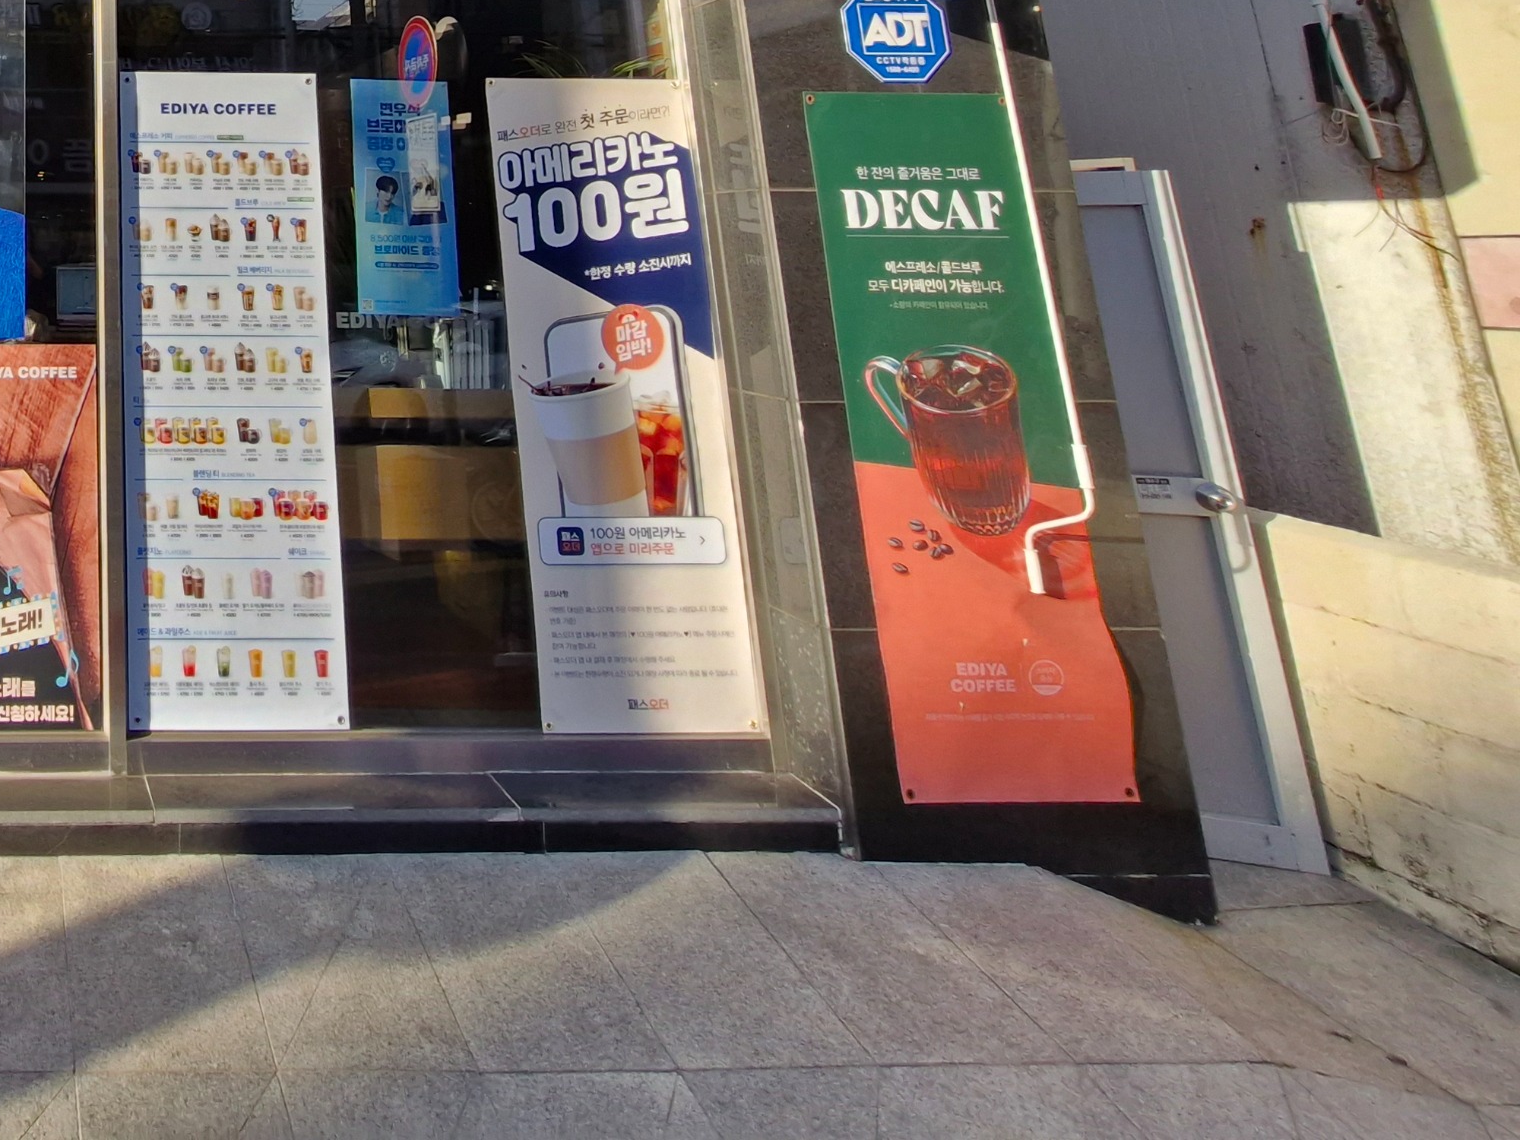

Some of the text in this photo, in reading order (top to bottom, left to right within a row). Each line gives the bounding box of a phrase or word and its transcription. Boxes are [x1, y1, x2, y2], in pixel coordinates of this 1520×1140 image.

[864, 11, 930, 47] ADT
[160, 102, 277, 115] EDIYA COFFEE
[496, 124, 553, 142] 패스오더로
[555, 120, 578, 135] 완전
[580, 111, 595, 130] 첫
[497, 131, 679, 190] 아메리카노
[856, 166, 982, 181] 한 잔의 즐거움은 그대로
[503, 168, 690, 253] 100원
[840, 189, 1004, 231] DECAF
[638, 252, 692, 274] 소진시까지
[868, 278, 1006, 294] 모두 디카페인이 가능합니다.
[336, 312, 402, 329] EDIYA
[615, 321, 648, 342] 마감
[615, 341, 652, 362] 임박!
[17, 366, 78, 380] COFFEE
[590, 526, 687, 540] 100원 아메리카노
[590, 542, 676, 556] 앱으로 미리주문
[0, 608, 43, 636] 노래!
[955, 662, 1008, 676] EDIYA
[950, 678, 1016, 692] COFFEE
[627, 698, 670, 711] 패스오더
